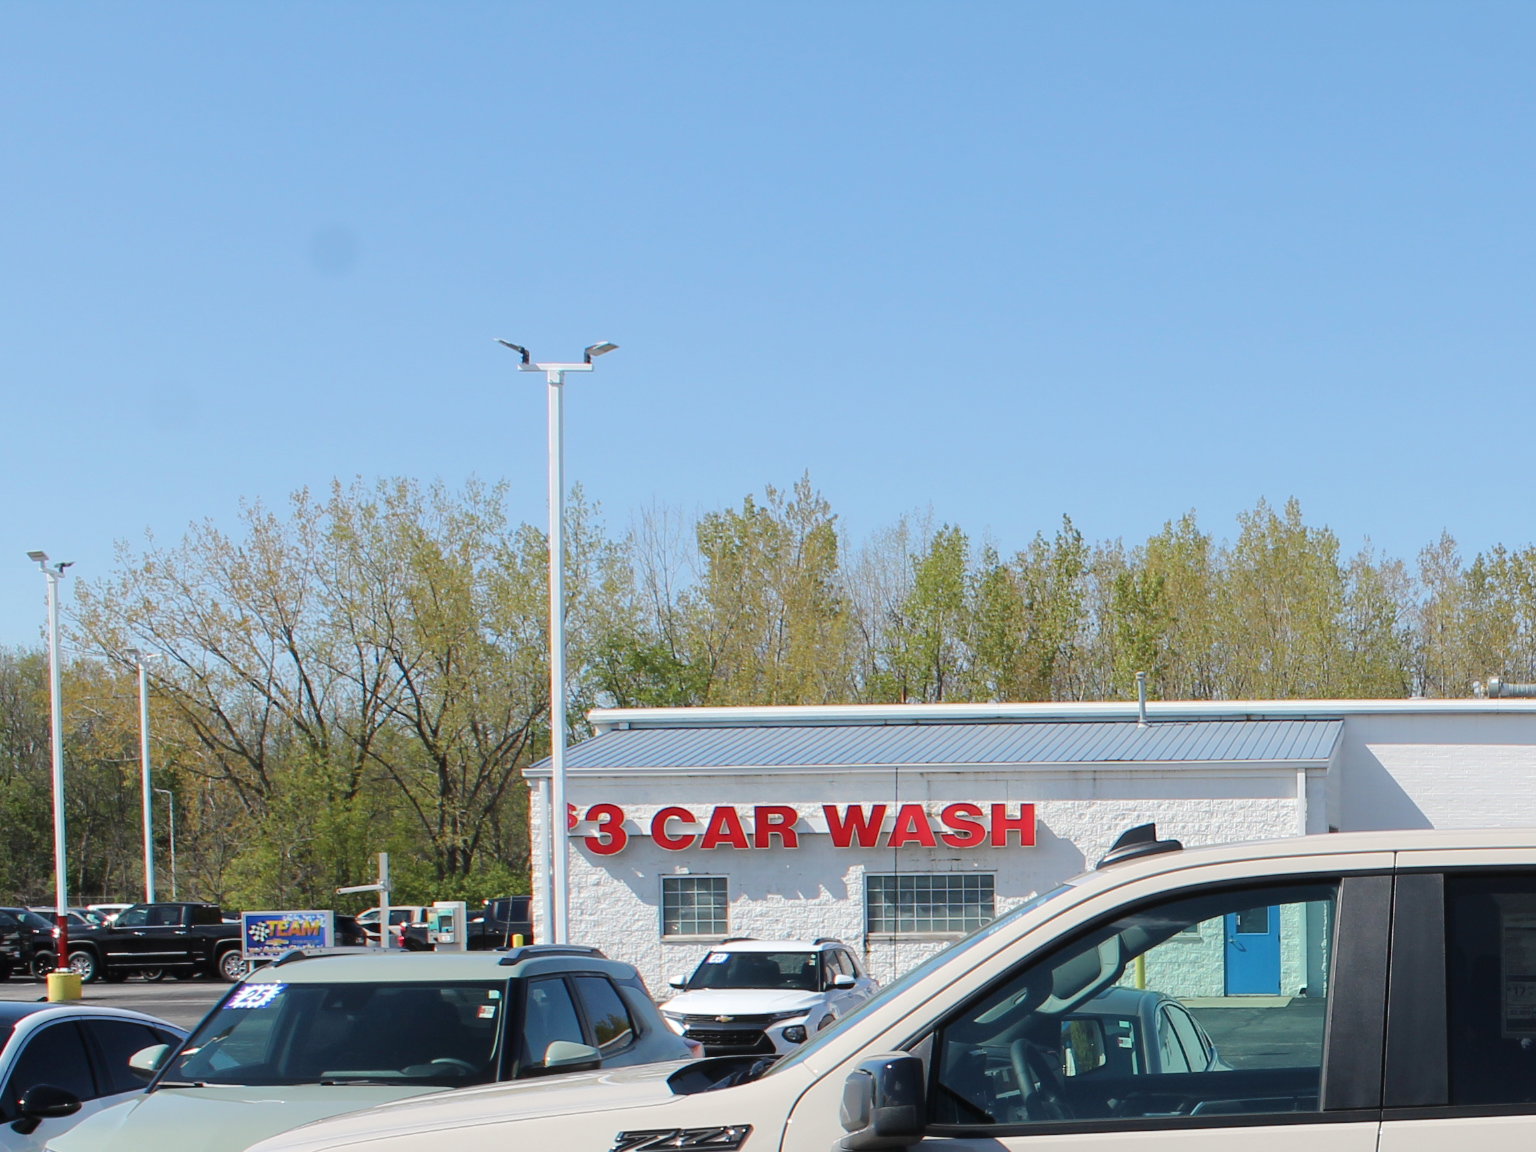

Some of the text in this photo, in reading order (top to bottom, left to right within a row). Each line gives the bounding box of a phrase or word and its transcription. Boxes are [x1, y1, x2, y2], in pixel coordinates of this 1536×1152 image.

[650, 805, 798, 851] CAR
[822, 803, 1036, 848] WASH
[266, 920, 321, 937] TEAM
[239, 989, 271, 1002] 25
